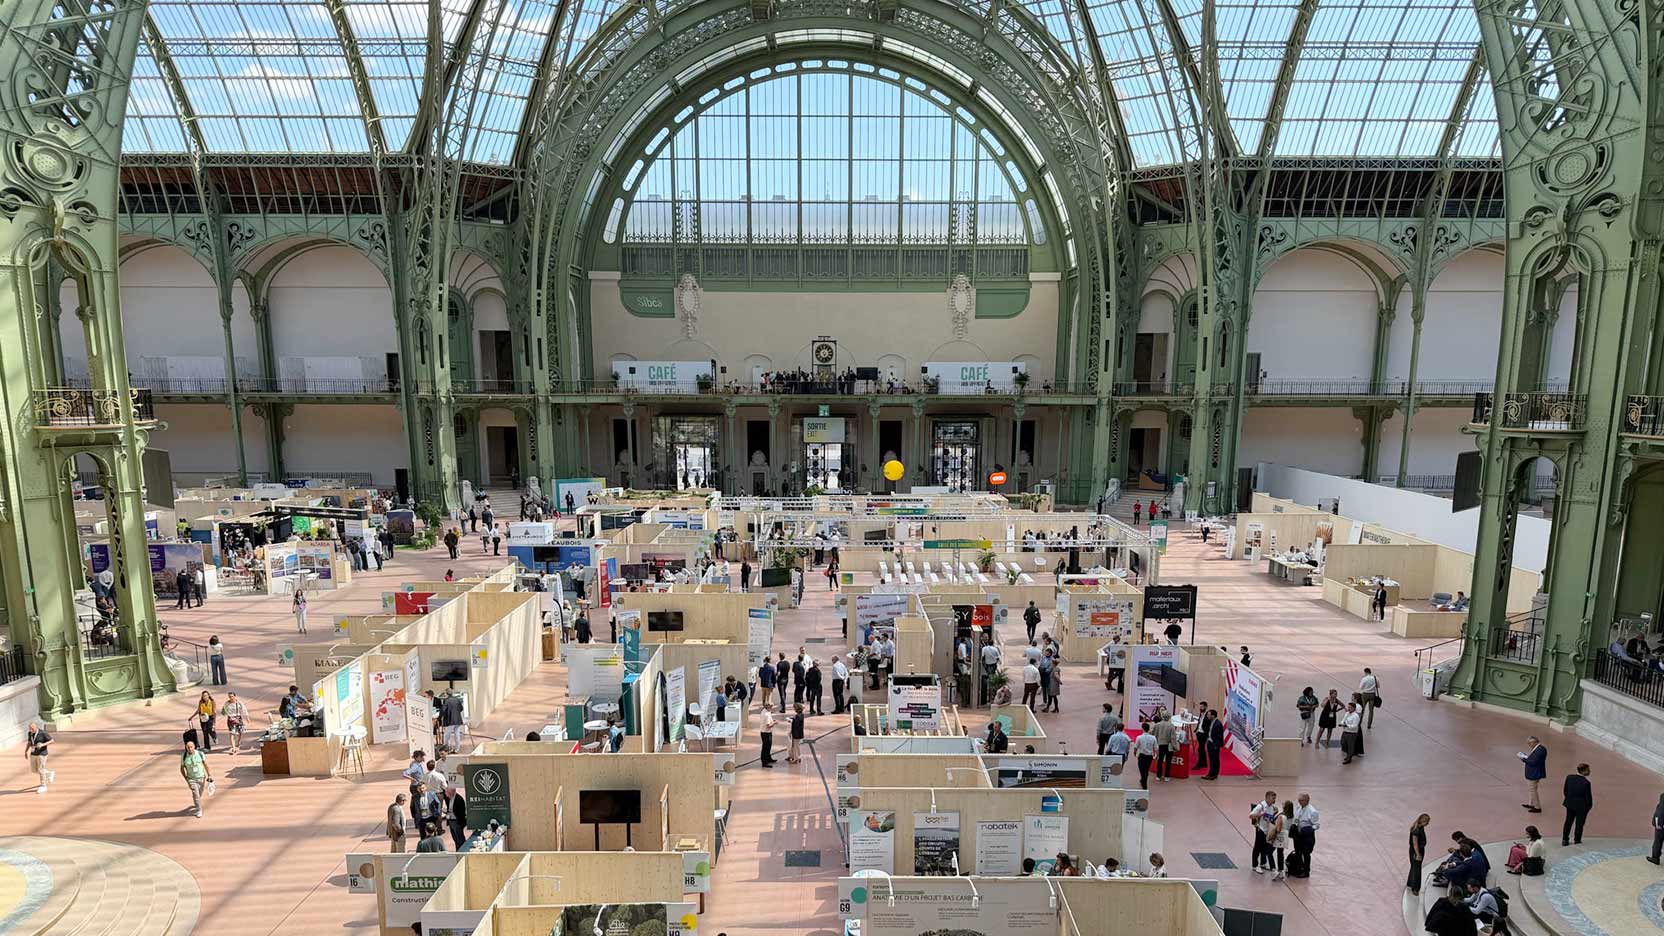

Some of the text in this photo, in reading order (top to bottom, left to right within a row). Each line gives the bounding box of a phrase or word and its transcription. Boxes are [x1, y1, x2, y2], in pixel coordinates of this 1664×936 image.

[648, 363, 677, 380] CAFÉ
[960, 363, 989, 381] CAFÉ
[807, 422, 828, 431] SORTIE
[684, 876, 695, 885] H8
[840, 903, 850, 912] G9
